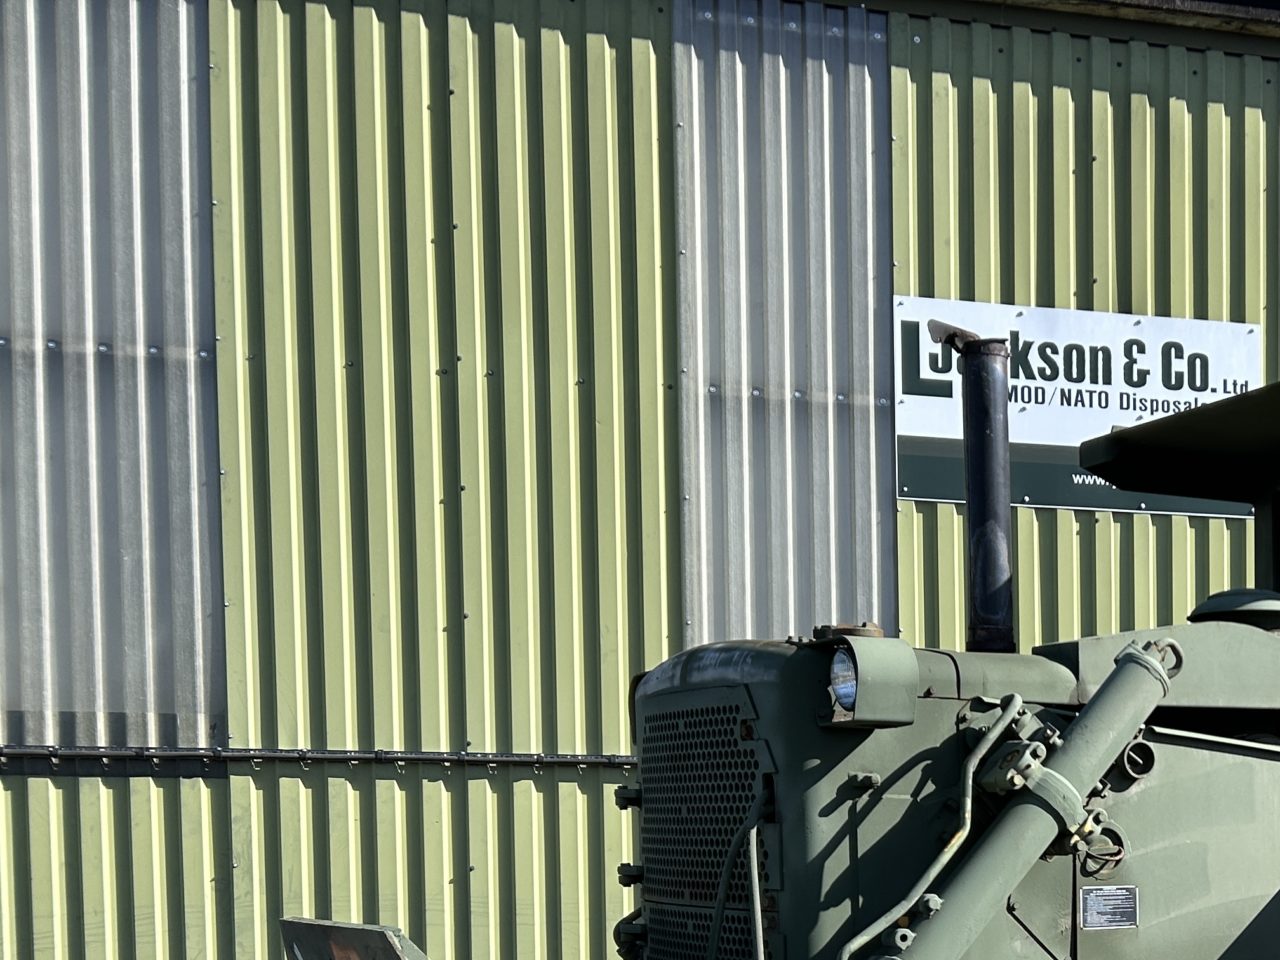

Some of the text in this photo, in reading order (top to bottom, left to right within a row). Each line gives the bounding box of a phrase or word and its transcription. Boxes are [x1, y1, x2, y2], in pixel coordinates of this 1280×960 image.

[1124, 339, 1150, 388] &
[1161, 341, 1217, 393] Co.
[1119, 393, 1208, 415] Disposal
